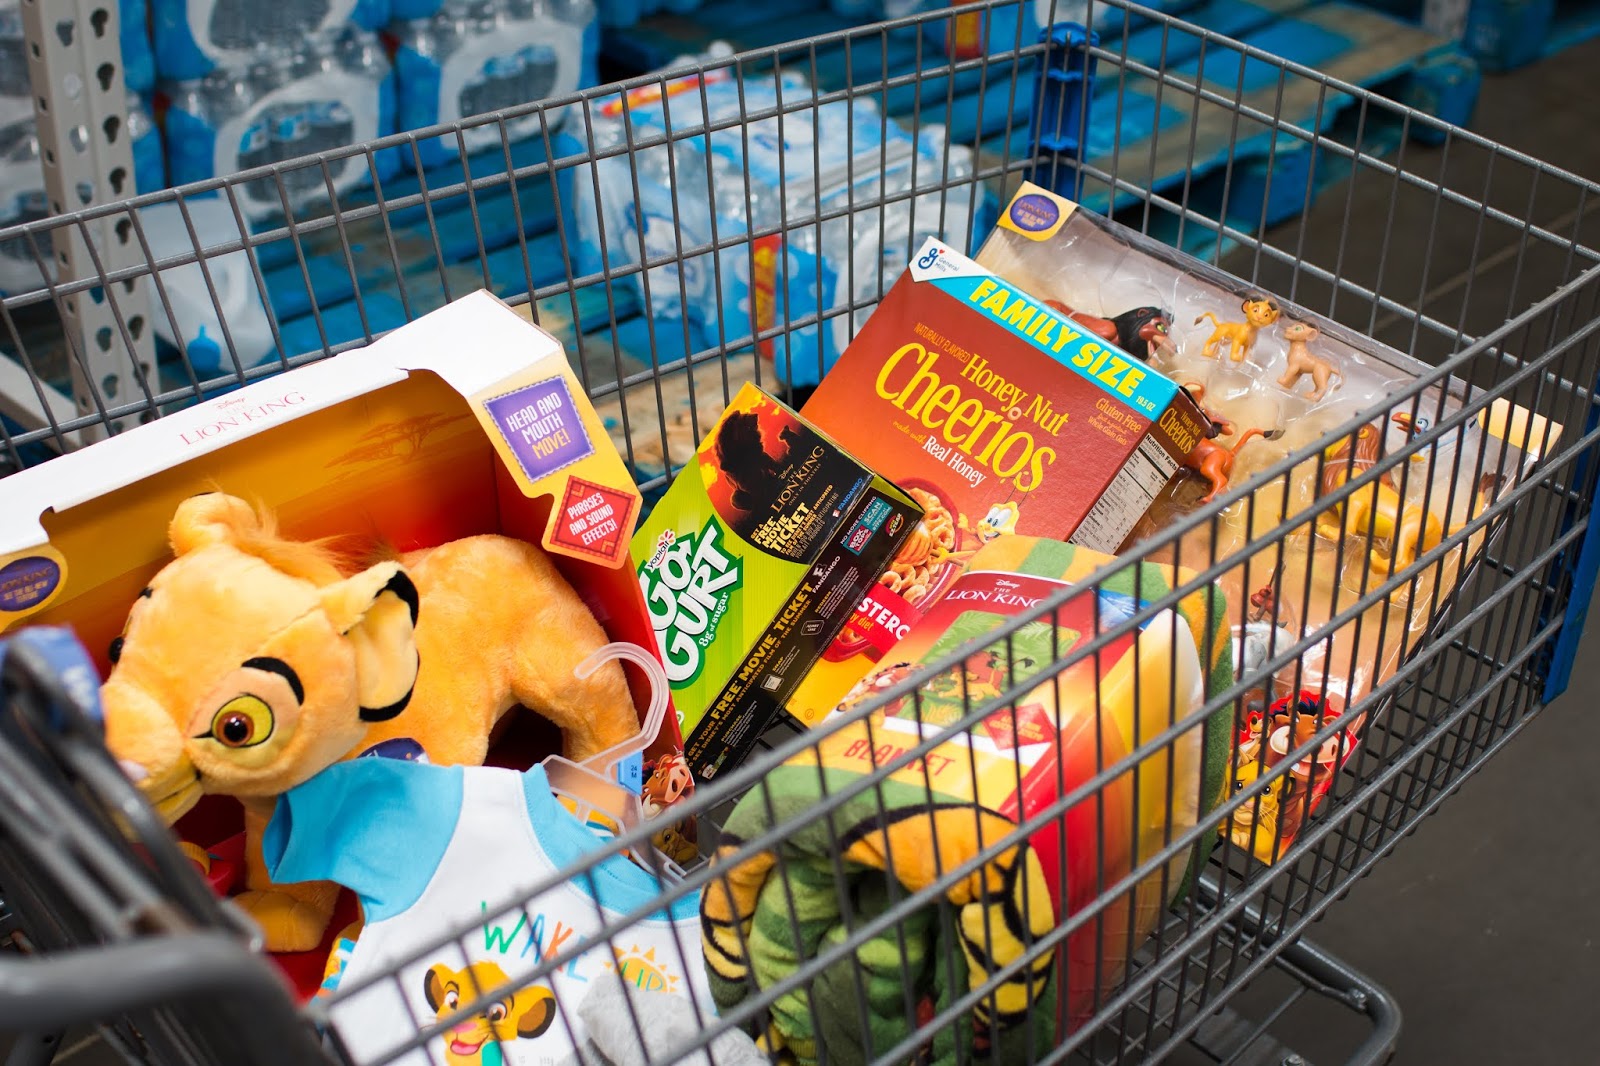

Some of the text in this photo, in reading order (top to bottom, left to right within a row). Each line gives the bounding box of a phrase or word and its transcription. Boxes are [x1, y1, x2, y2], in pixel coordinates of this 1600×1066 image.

[914, 322, 971, 363] NATURALLY FLAVORED
[968, 278, 1147, 398] FAMILY SIZE
[960, 354, 1070, 436] Honey Nut
[180, 392, 304, 444] LION KING
[506, 392, 562, 432] HEAD AND
[521, 412, 564, 444] MOUTH
[875, 342, 1057, 492] Cheerios
[1096, 398, 1142, 433] Gluten Free
[531, 428, 571, 460] MOVE!
[892, 420, 928, 445] made with
[1088, 416, 1128, 446] Whole Grain Oats
[1158, 407, 1196, 454] Cheerios
[922, 435, 988, 488] Real Honey
[1145, 434, 1165, 458] Nutrition
[1164, 455, 1179, 471] Facts
[771, 446, 824, 512] LION KING
[779, 463, 793, 479] Disney
[567, 492, 604, 520] PHRASES
[813, 485, 832, 509] ANTICIPATED
[837, 478, 863, 509] FANDANGO
[569, 504, 614, 536] AND SOUND
[769, 503, 810, 552] TICKET
[840, 535, 847, 544] NO
[847, 519, 858, 534] MORE
[858, 495, 875, 519] CLIPPING
[864, 501, 879, 522] SCAN
[581, 520, 618, 546] EFFECTS!
[750, 528, 760, 539] GET
[762, 515, 788, 547] MOVIE
[849, 529, 863, 548] BOX
[855, 528, 868, 547] TOPS
[648, 540, 670, 569] yoplait
[812, 556, 840, 592] FANDANGO
[996, 579, 1020, 588] Disney
[654, 524, 738, 682] GURT
[946, 590, 992, 600] LION
[699, 592, 728, 646] 8g of sugar
[857, 616, 874, 632] diet
[688, 742, 699, 755] GET
[699, 720, 715, 740] YOUR
[738, 633, 776, 681] MOVIE
[773, 582, 815, 632] TICKET
[773, 657, 783, 670] SNAP
[692, 749, 702, 761] SEE
[701, 721, 723, 748] DISNEY'S
[722, 703, 735, 719] MOST
[735, 664, 764, 701] ANTICIPATED
[763, 649, 775, 663] FILM
[774, 640, 781, 648] OF
[781, 627, 791, 639] THE
